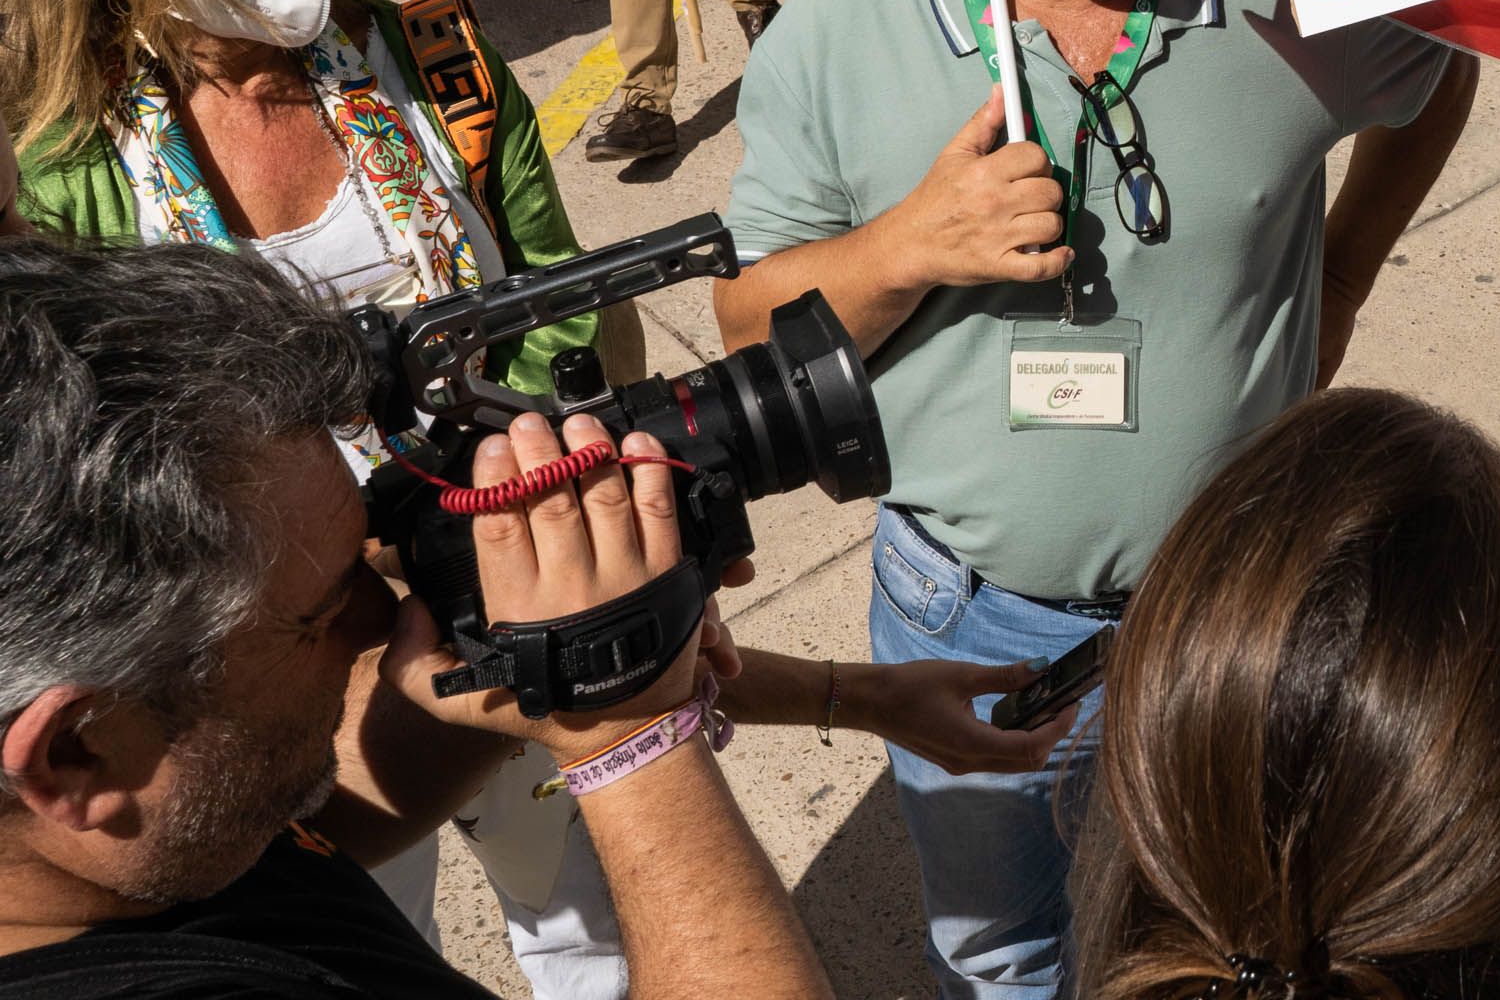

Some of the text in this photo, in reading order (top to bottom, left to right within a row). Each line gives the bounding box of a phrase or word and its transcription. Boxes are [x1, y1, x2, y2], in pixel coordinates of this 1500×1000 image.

[1017, 363, 1118, 375] DELEGADO SINDICAL
[573, 658, 657, 697] Panasonic
